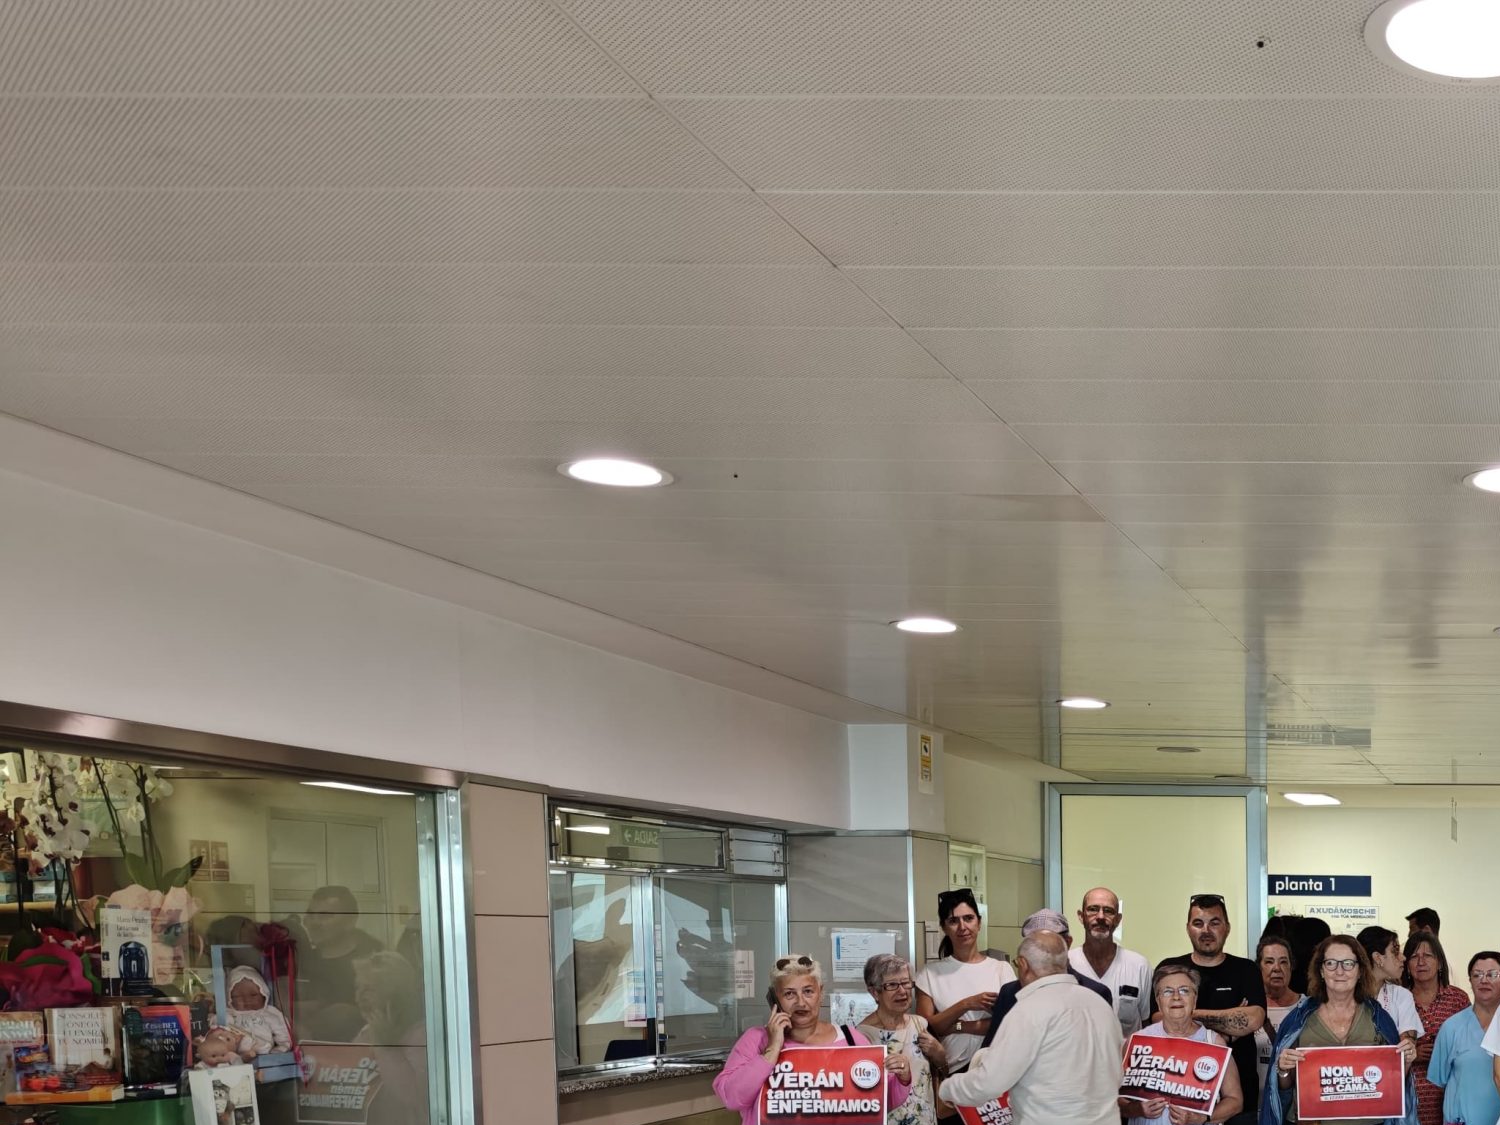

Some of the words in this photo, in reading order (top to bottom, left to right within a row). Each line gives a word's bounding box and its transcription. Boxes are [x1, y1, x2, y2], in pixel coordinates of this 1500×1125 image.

[1275, 876, 1323, 894] planta
[1330, 878, 1335, 891] 1
[1132, 1045, 1152, 1054] no
[1130, 1055, 1188, 1075] VERÁN
[1321, 1066, 1353, 1077] NON
[769, 1069, 843, 1088] VERÁN
[1126, 1068, 1166, 1079] tamén
[1333, 1076, 1363, 1085] PECHE
[767, 1087, 821, 1100] tamén
[1122, 1077, 1211, 1100] ENFERMAMOS
[1336, 1084, 1376, 1092] CAMAS
[767, 1099, 880, 1114] ENFERMAMOS
